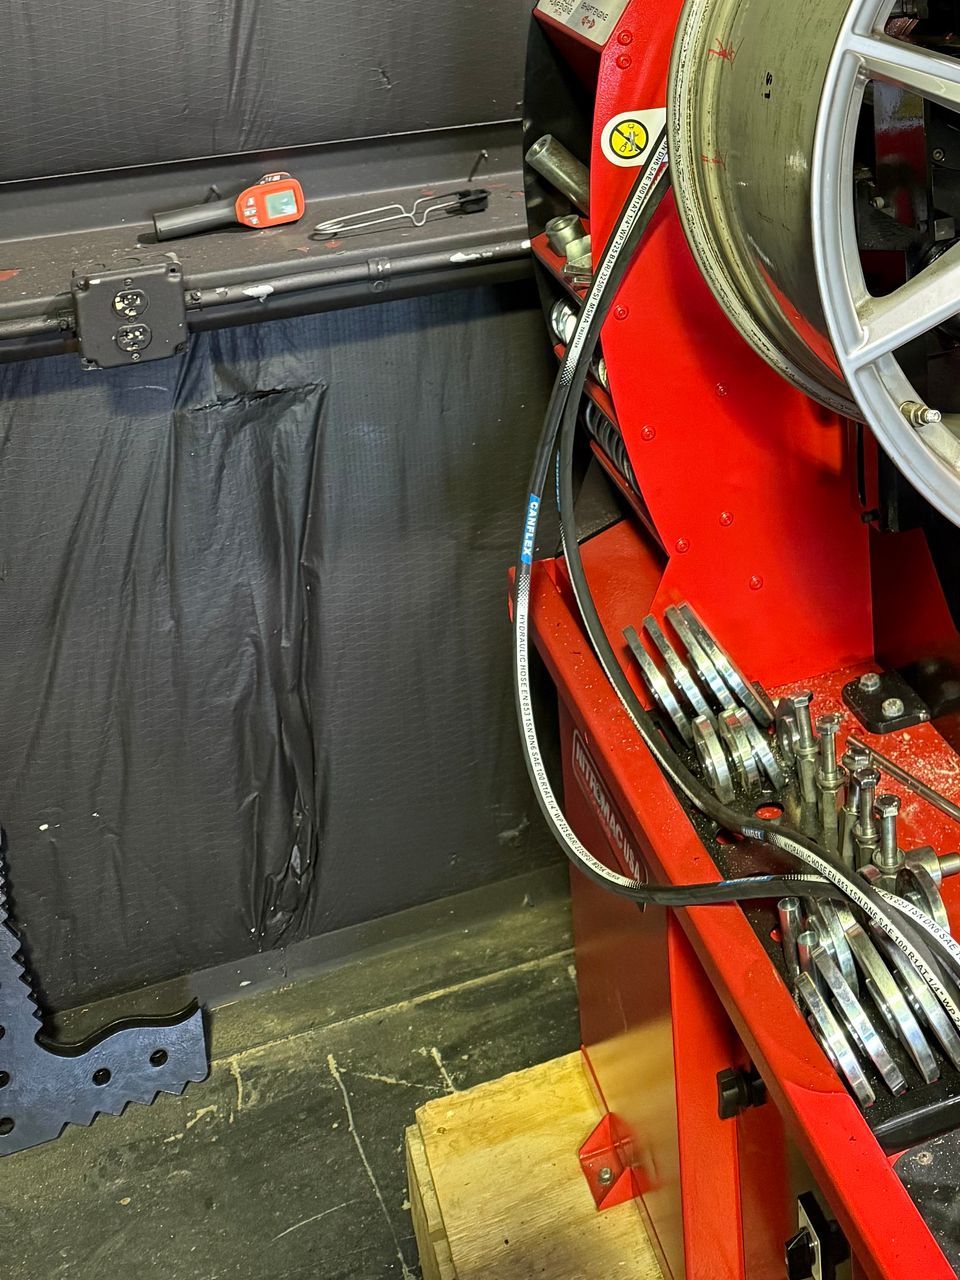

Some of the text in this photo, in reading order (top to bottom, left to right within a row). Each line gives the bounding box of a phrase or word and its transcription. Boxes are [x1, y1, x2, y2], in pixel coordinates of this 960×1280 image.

[646, 167, 658, 181] SAE
[640, 182, 650, 195] 100
[630, 195, 642, 214] R1AT
[618, 228, 628, 242] WP
[611, 241, 621, 254] 225
[583, 302, 597, 324] MSHA
[524, 501, 540, 556] CANFLEX
[518, 614, 526, 663] HYDRAULIC
[519, 664, 528, 688] HOSE
[521, 689, 529, 701] EN
[522, 702, 531, 716] 853
[525, 718, 533, 733] 1SN
[528, 734, 537, 751] DN6
[532, 751, 541, 768] SAE
[536, 768, 546, 781] 100
[540, 781, 553, 799] R1AT
[623, 837, 640, 882] USA
[784, 842, 812, 864] HYDRAULIC
[810, 858, 827, 875] HOSE
[828, 870, 837, 881] EN
[837, 878, 849, 893] 853
[849, 889, 863, 904] 1SN
[862, 902, 878, 919] DN6
[878, 917, 895, 936] SAE
[894, 936, 908, 952] 100
[907, 951, 930, 977] R1AT
[942, 997, 956, 1015] WP
[908, 907, 926, 920] 1SN
[922, 918, 941, 934] DN6
[938, 932, 959, 951] SAE
